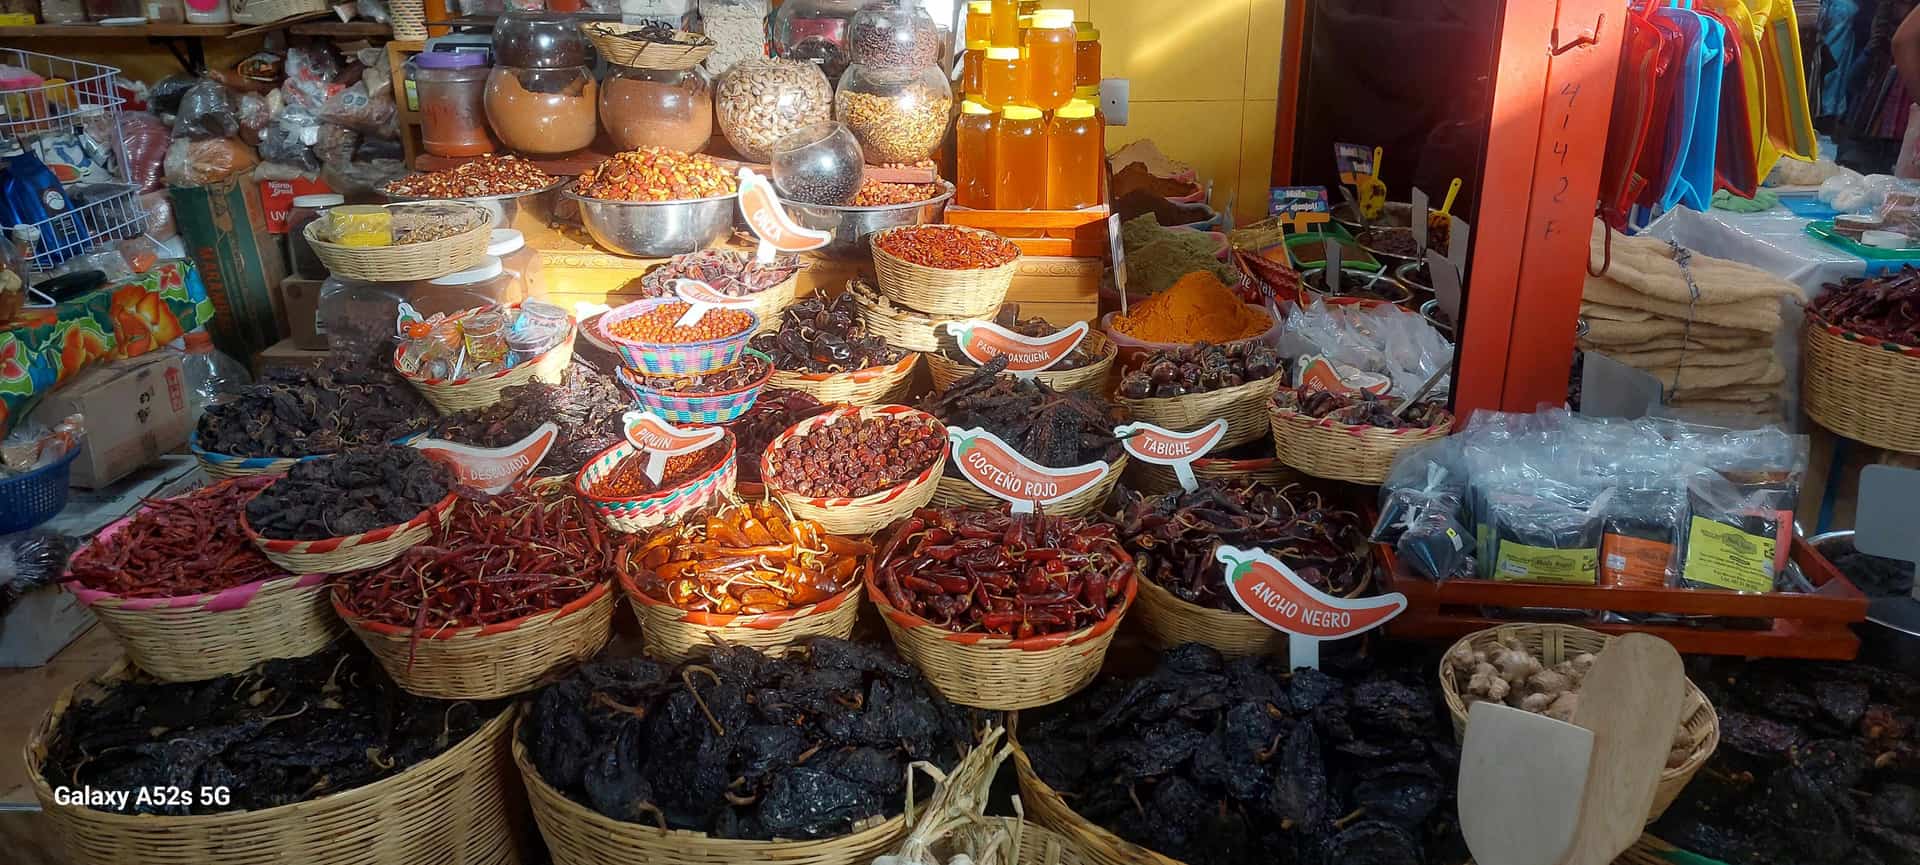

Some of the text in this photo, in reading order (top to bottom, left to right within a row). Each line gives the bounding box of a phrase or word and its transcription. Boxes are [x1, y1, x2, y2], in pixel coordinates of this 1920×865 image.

[1143, 436, 1192, 456] TABICHE
[968, 452, 1058, 497] COSTEÑO ROJO
[1250, 581, 1350, 628] ANCHO NEGRO
